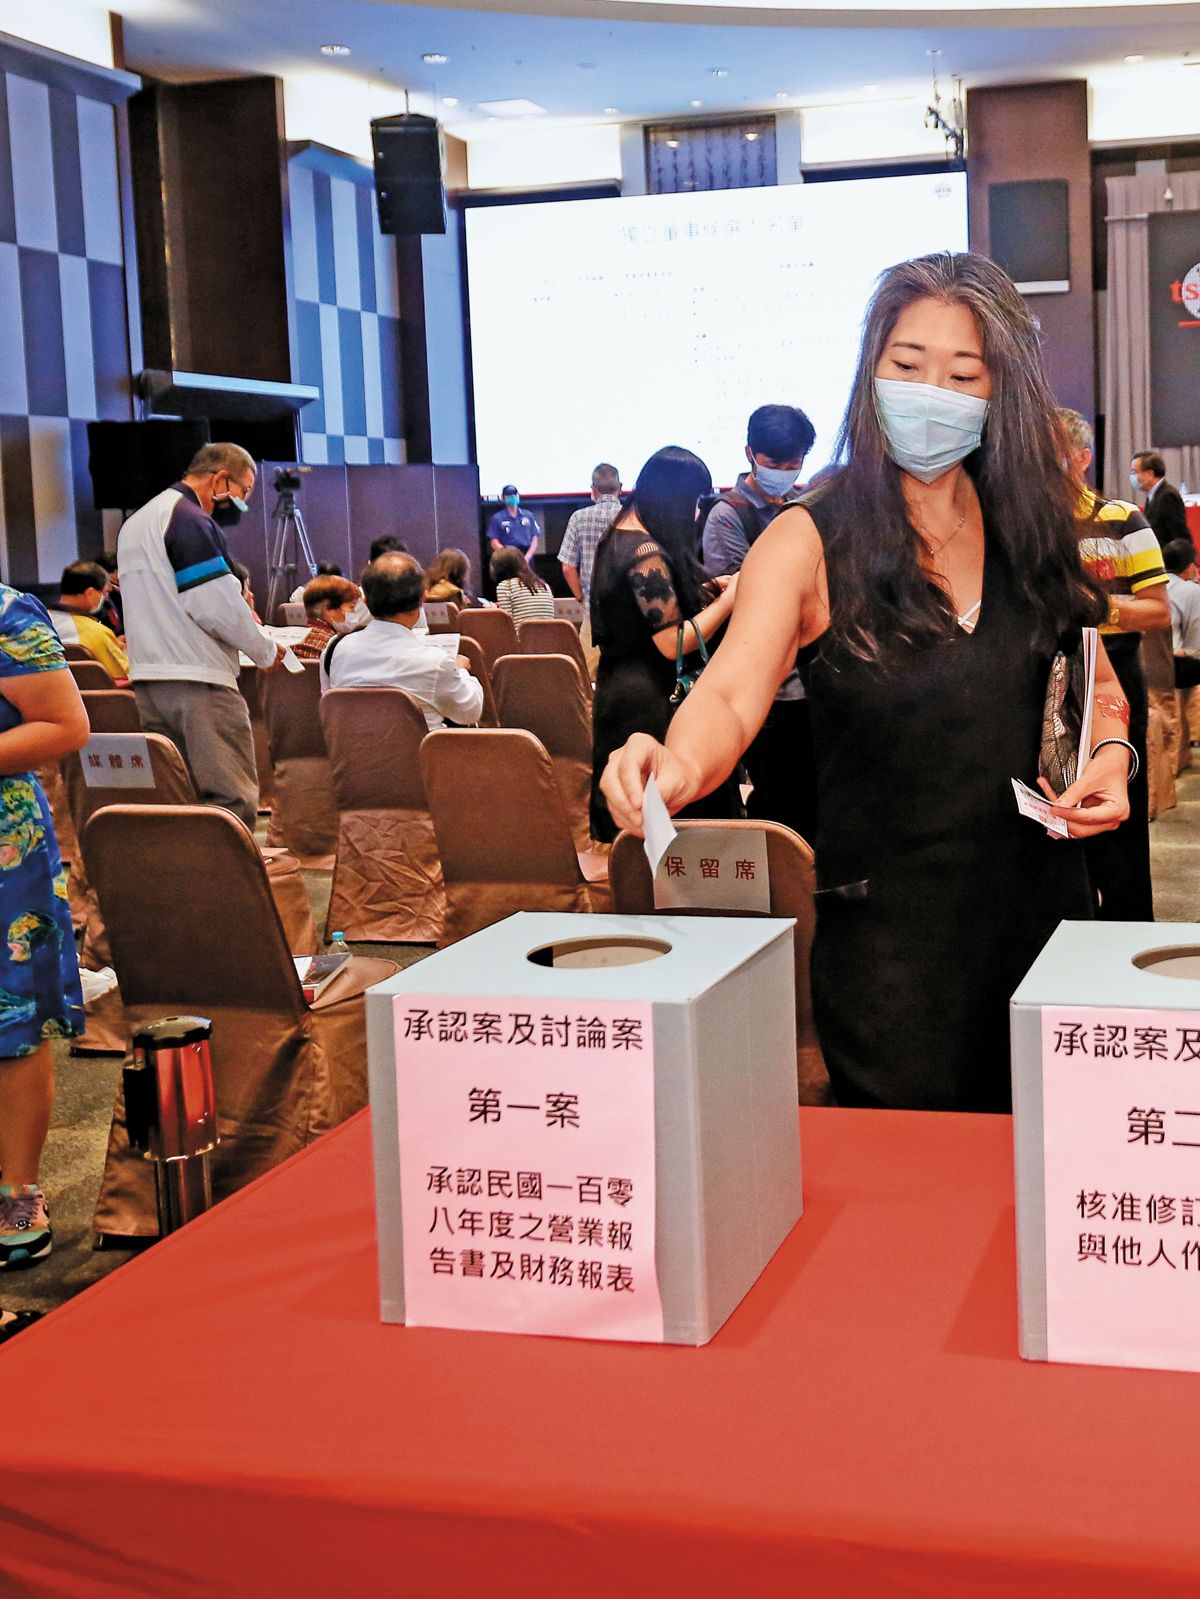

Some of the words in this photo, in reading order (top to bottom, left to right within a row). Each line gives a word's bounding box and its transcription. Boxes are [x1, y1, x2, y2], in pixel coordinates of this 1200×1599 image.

[664, 856, 755, 880] 保留席
[404, 1009, 643, 1050] 承認案及討論案
[468, 1087, 580, 1129] 第一案
[426, 1165, 634, 1208] 承認民國一百零
[428, 1206, 634, 1252] 八年度之營業報
[429, 1246, 636, 1293] 告書及財務報表
